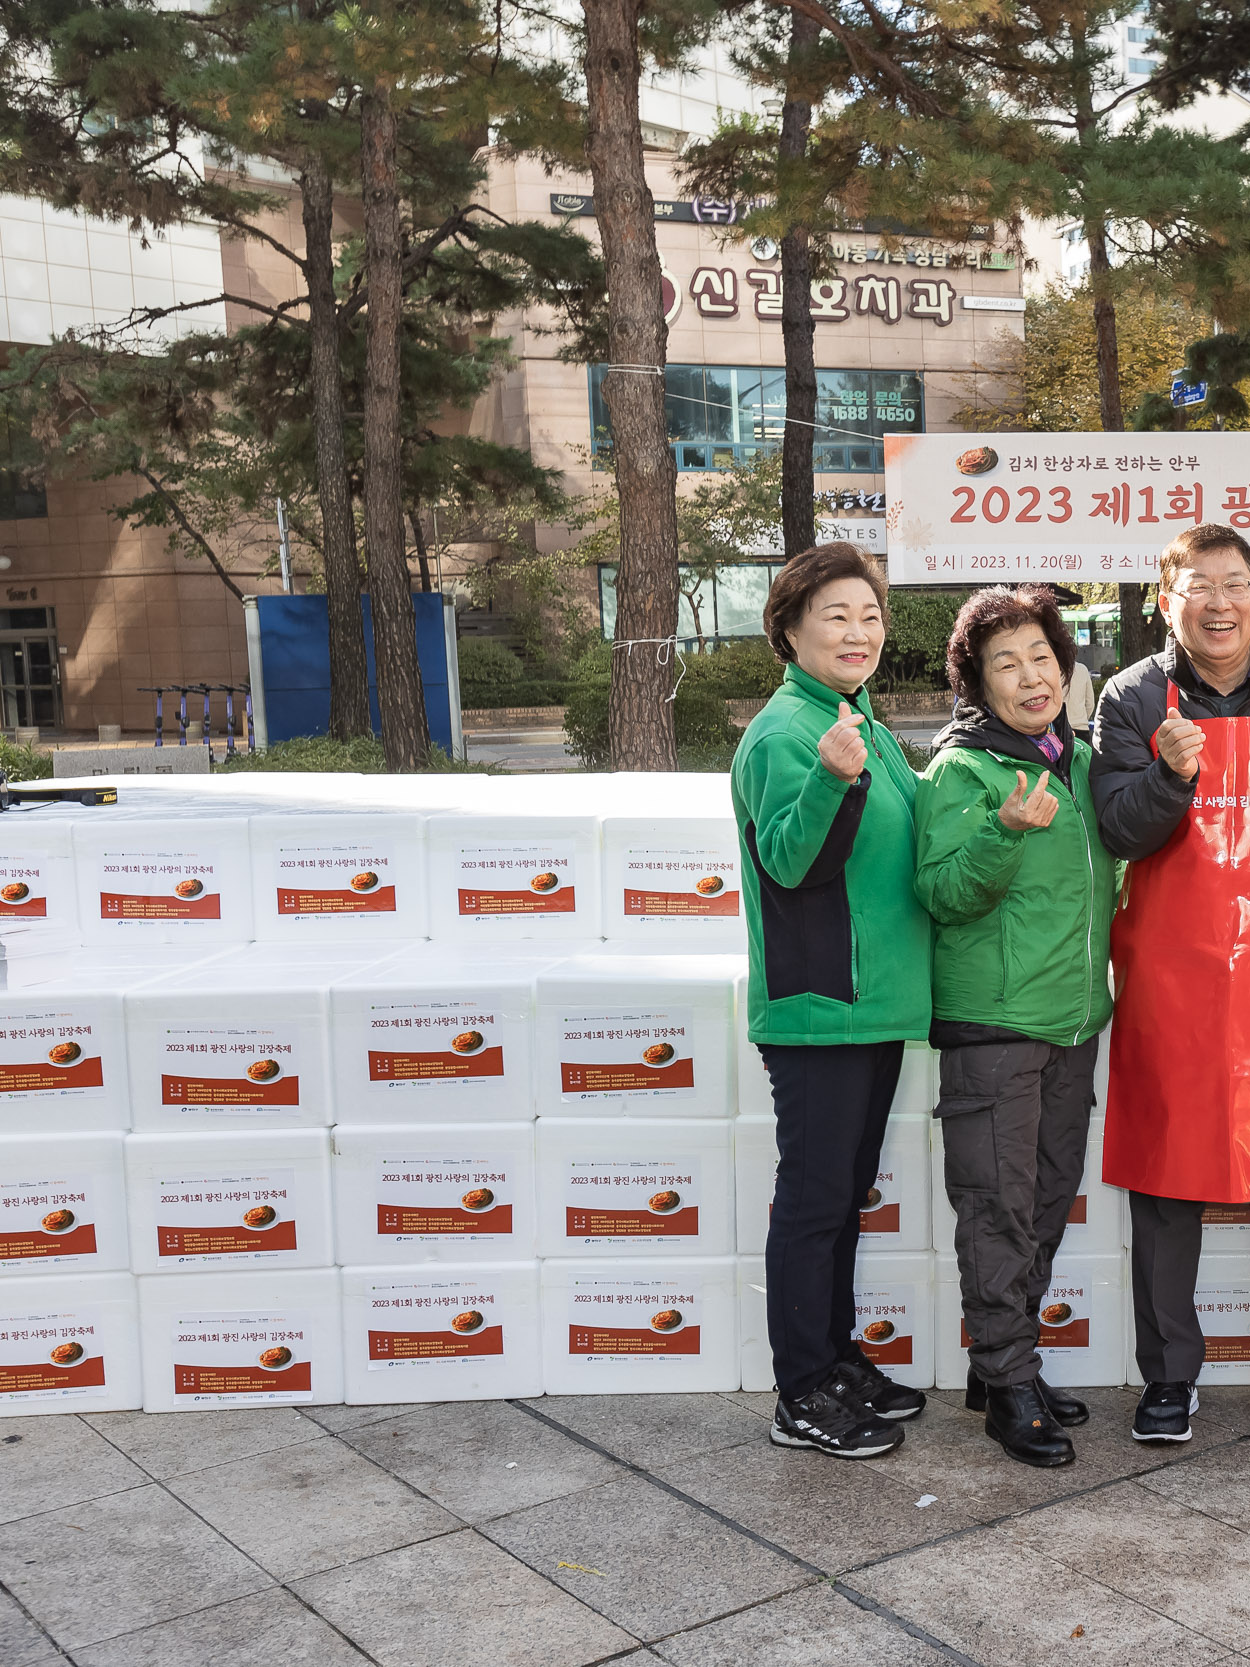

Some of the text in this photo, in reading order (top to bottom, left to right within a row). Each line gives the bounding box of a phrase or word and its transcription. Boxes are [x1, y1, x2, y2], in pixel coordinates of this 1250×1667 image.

[832, 406, 915, 422] 1688 4650
[1008, 455, 1201, 472] 김치 한상자로 전하는 안부
[950, 485, 1073, 524] 2023
[1088, 481, 1203, 528] 제1회
[1040, 554, 1083, 571] 20(월)
[1192, 796, 1203, 809] 진
[1205, 796, 1237, 808] 사랑의
[121, 865, 140, 873] 제1회
[142, 865, 157, 873] 광진
[184, 866, 213, 874] 김장축제
[297, 860, 315, 868] 제1회
[318, 859, 332, 868] 광진
[334, 859, 356, 867] 사랑의
[359, 858, 388, 866] 김장축제
[499, 860, 513, 868] 광진
[515, 860, 536, 868] 사랑의
[539, 859, 567, 867] 김장축제
[665, 862, 679, 870] 광진
[681, 862, 702, 871] 사랑의
[706, 863, 733, 871] 김장축제
[371, 1015, 494, 1028] 2023 제1회 광진 사랑의 김장축제
[10, 1026, 91, 1039] 광진 사랑의 김장축제
[564, 1027, 684, 1040] 2023 제1회 광진 사랑의 김장축제
[166, 1044, 291, 1053] 2023 제1회 광진 사랑의 김장축제
[382, 1173, 505, 1183] 2023 제1회 광진 사랑의 김장축제
[571, 1176, 691, 1185] 2023 제1회 광진 사랑의 김장축제
[2, 1193, 85, 1207] 광진 사랑의 김장축제
[161, 1190, 286, 1204] 2023 제1회 광진 사랑의 김장축제
[372, 1295, 494, 1308] 2023 제1회 광진 사랑의 김장축제
[574, 1295, 693, 1304] 2023 제1회 광진 사랑의 김장축제
[11, 1326, 94, 1340] 광진 사랑의 김장축제
[198, 1333, 219, 1342] 제1회
[222, 1333, 238, 1342] 광진
[241, 1332, 266, 1341] 사랑의
[270, 1331, 303, 1341] 김장축제
